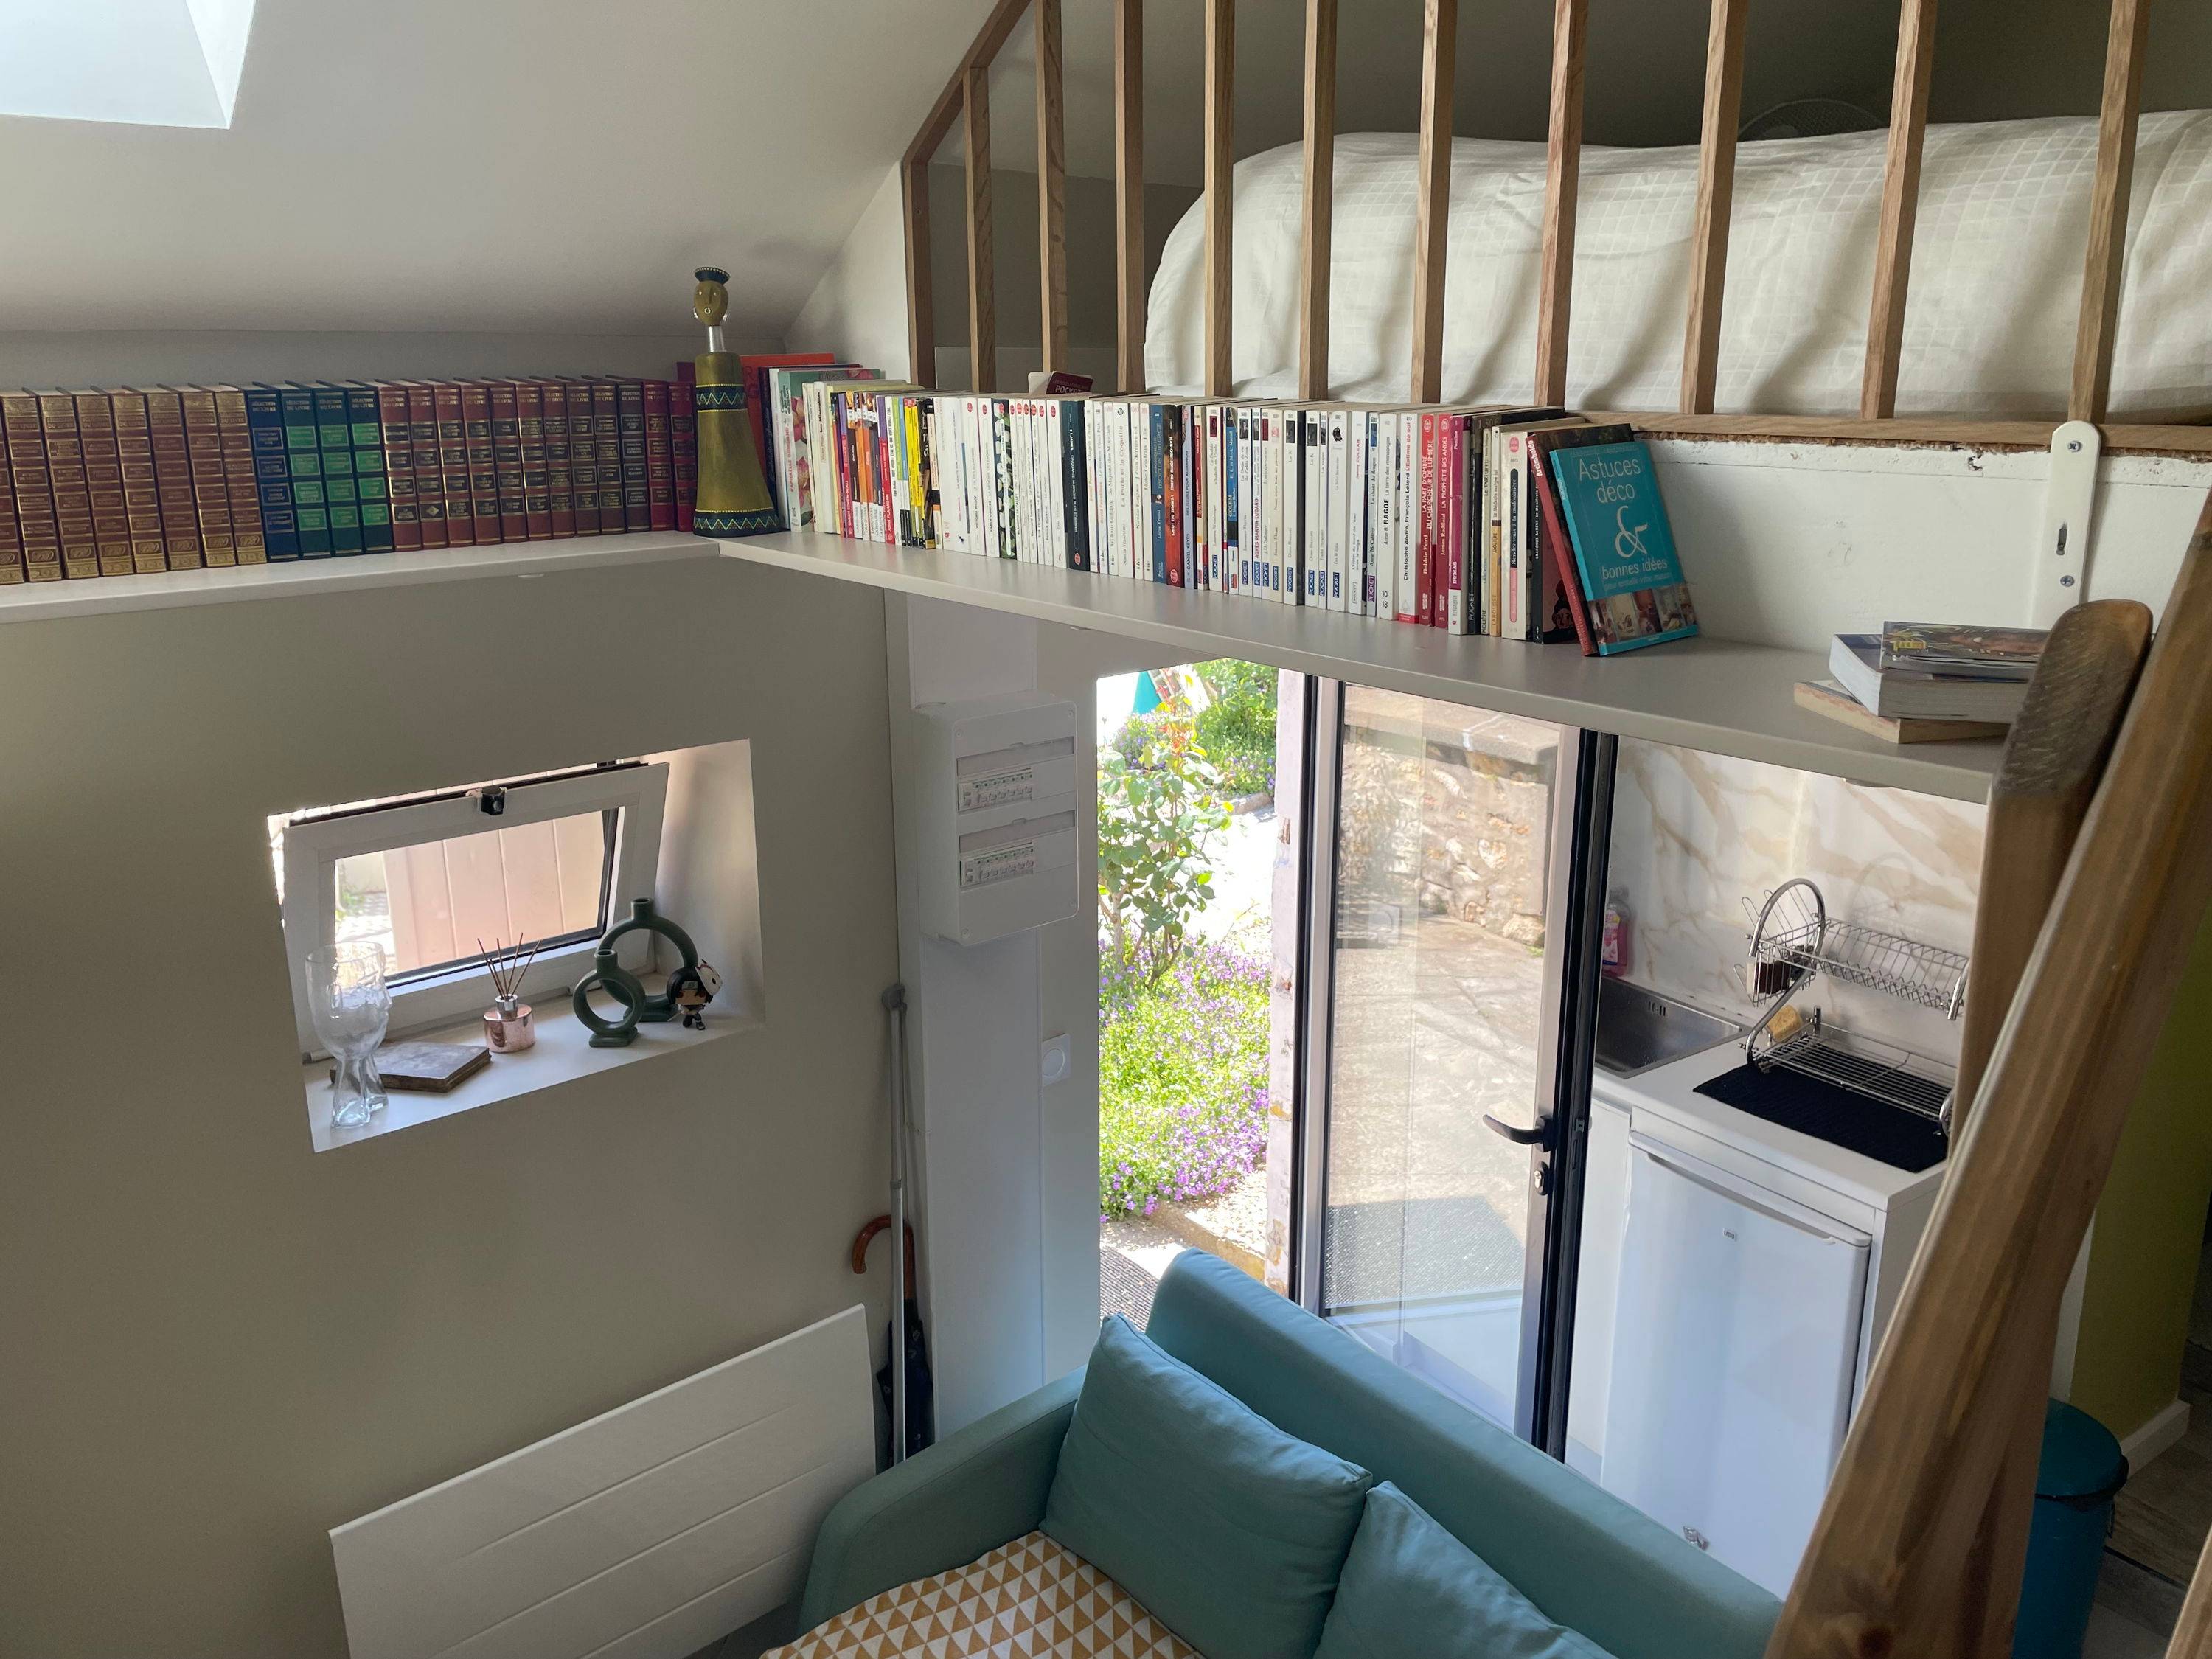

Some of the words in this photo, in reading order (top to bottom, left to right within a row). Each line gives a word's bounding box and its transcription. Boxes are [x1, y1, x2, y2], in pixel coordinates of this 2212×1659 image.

[1406, 434, 1411, 443] de
[1528, 440, 1543, 477] Arcimboldo
[1427, 470, 1433, 478] DE
[1579, 457, 1641, 482] Astuces
[1597, 480, 1635, 504] déco
[1422, 505, 1427, 513] LA
[1441, 500, 1447, 508] LA
[1426, 519, 1433, 529] DU
[1615, 505, 1648, 558] &
[1601, 565, 1640, 580] bonnes
[1641, 557, 1668, 572] idées
[1382, 600, 1388, 608] 18
